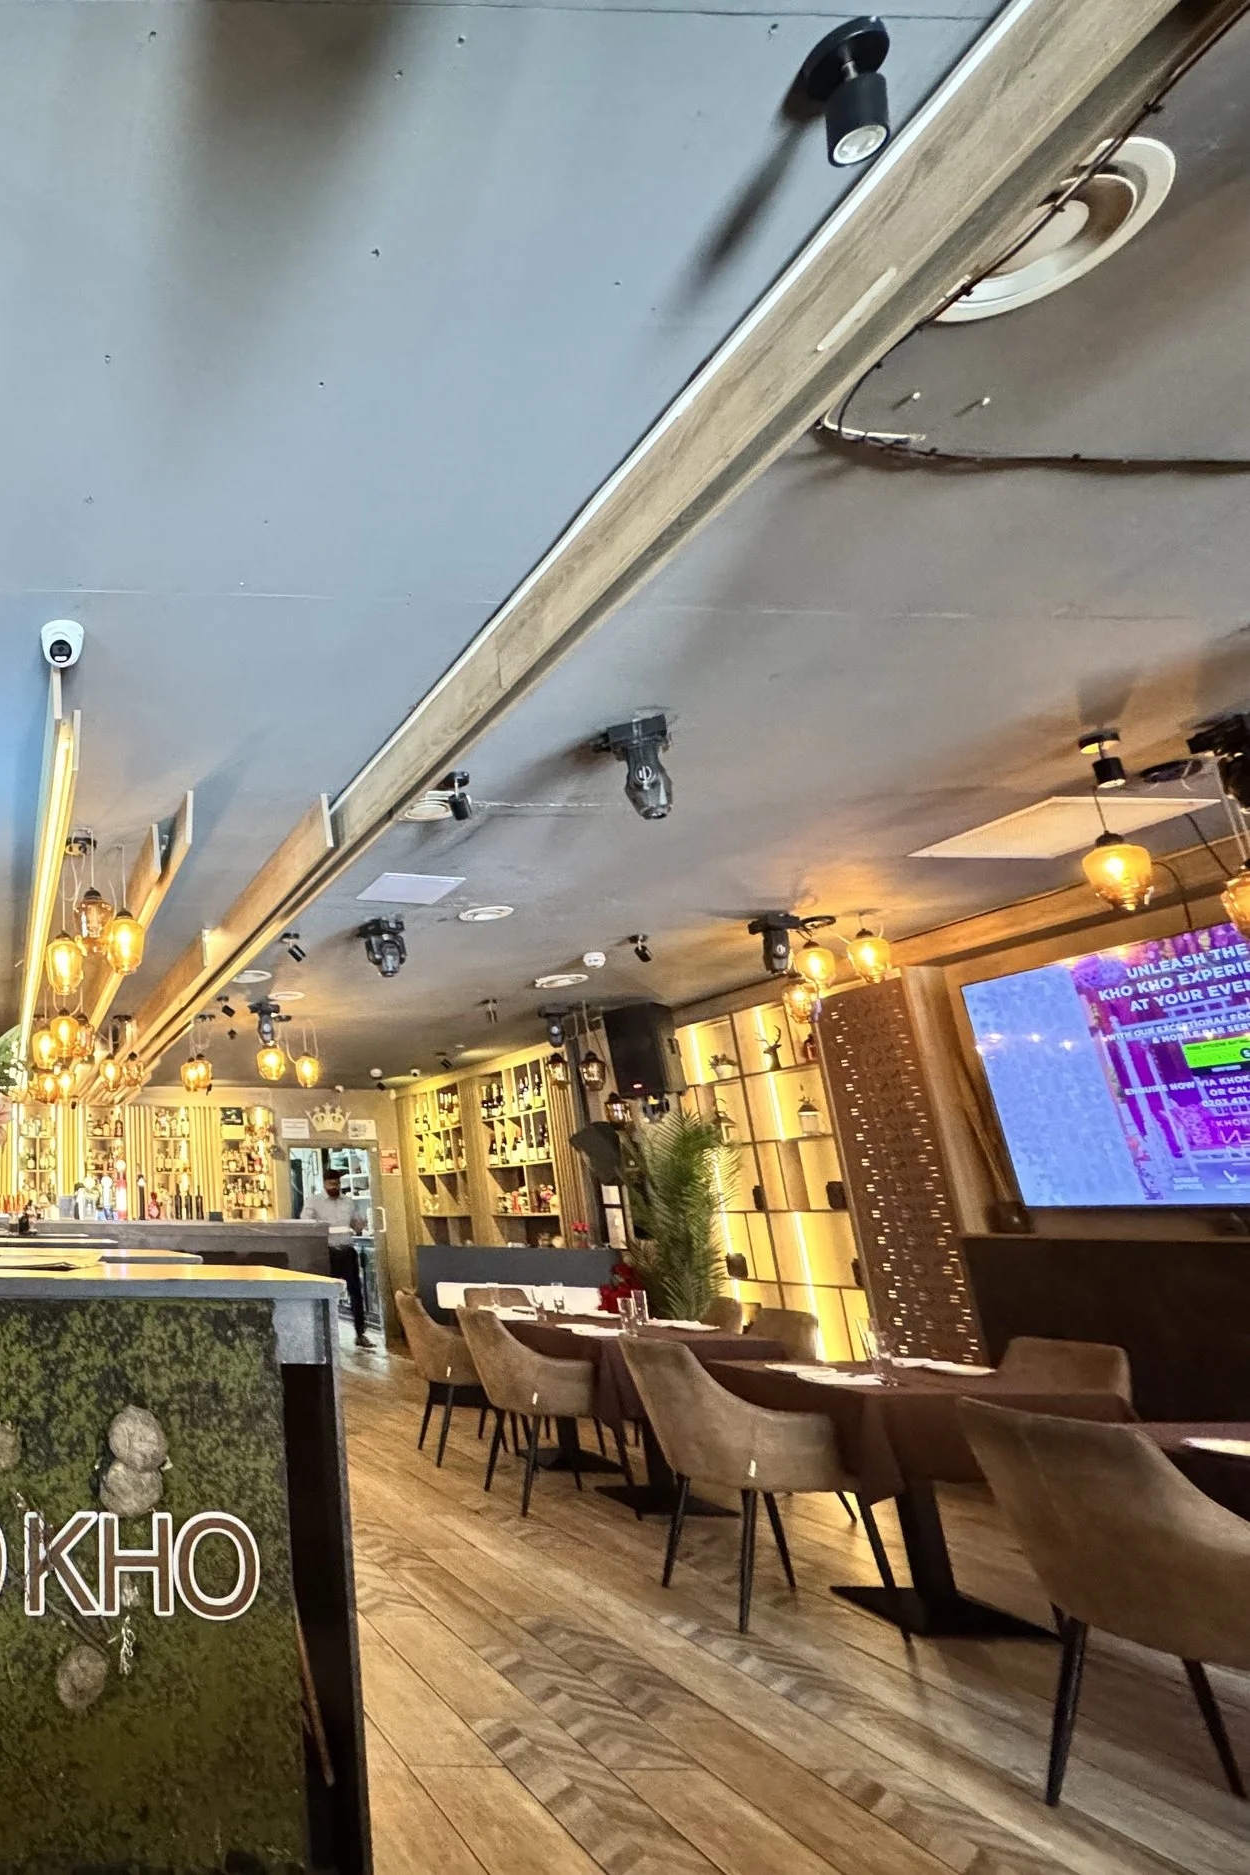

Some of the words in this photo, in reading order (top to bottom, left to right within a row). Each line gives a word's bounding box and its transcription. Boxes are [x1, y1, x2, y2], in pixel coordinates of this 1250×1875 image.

[1125, 952, 1208, 979] UNLEASH
[1209, 943, 1250, 961] THE
[1098, 985, 1133, 1001] KHO
[1136, 976, 1174, 994] KHO
[1130, 998, 1150, 1012] AT
[1153, 988, 1204, 1007] YOUR
[1107, 1031, 1132, 1042] WITH
[1134, 1027, 1155, 1037] OUR
[1156, 1015, 1229, 1034] EXCEPTIONAL
[1161, 1030, 1202, 1043] MOBILE
[1169, 1081, 1195, 1091] NOW
[1198, 1079, 1217, 1087] VIA
[1209, 1088, 1226, 1096] OR
[23, 1510, 261, 1622] KHO
